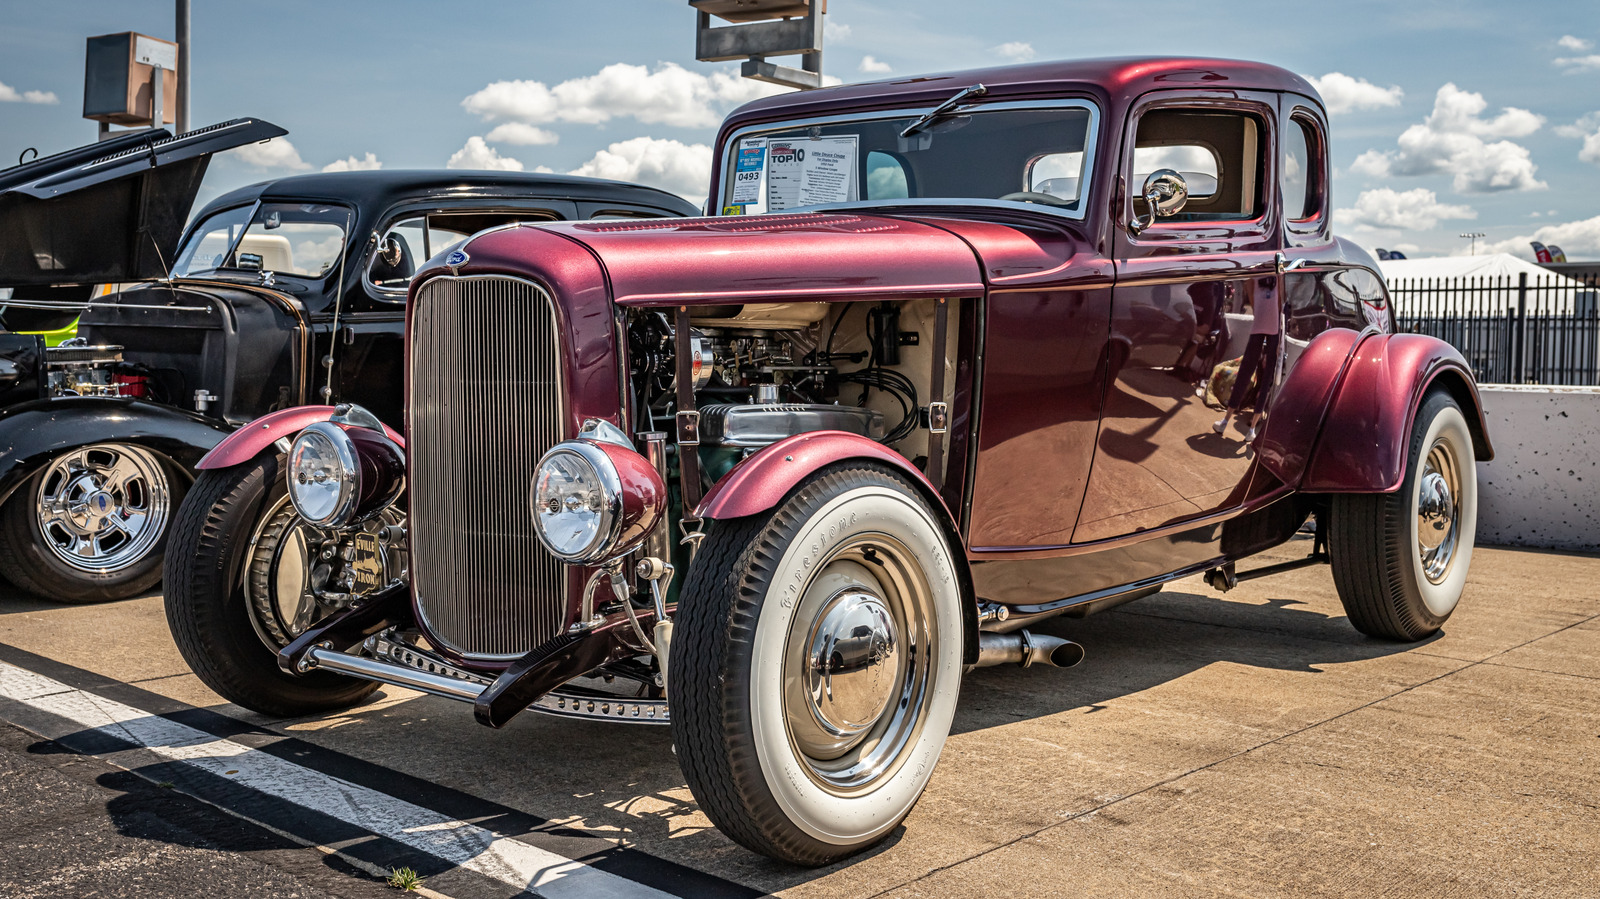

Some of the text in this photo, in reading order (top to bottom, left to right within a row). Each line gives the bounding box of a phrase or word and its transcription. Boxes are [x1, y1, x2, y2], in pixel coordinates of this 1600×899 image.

[738, 172, 759, 181] 0493
[357, 538, 375, 552] EVILLE
[357, 572, 375, 584] IRON
